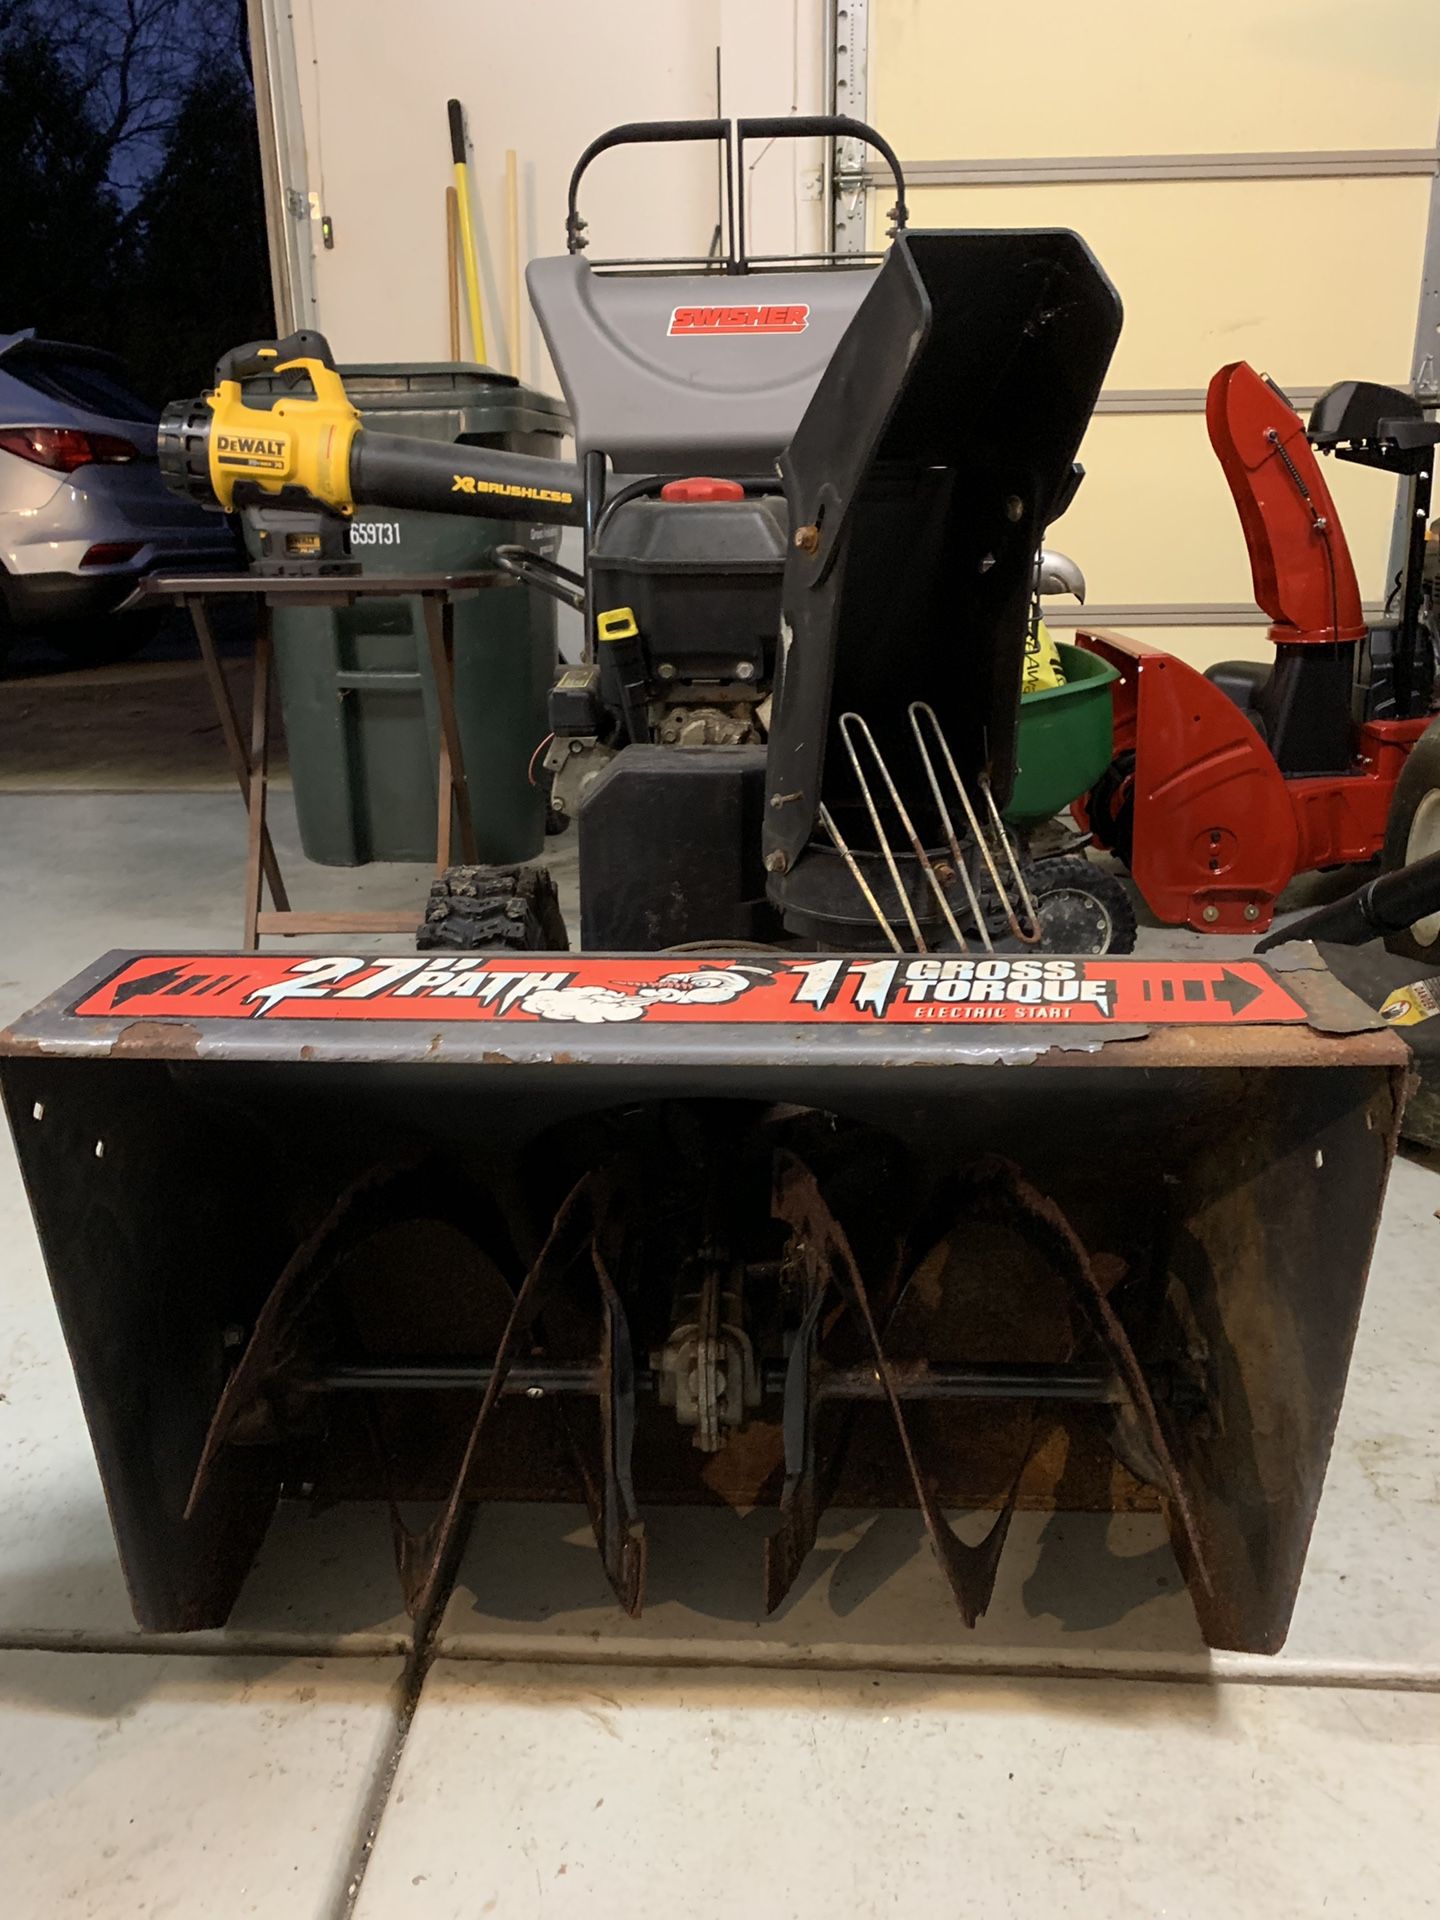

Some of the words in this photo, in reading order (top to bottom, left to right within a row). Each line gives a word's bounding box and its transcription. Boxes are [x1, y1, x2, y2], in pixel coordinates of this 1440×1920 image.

[673, 304, 809, 327] SWISHER
[452, 475, 477, 494] XR
[477, 481, 573, 504] BRUSHLESS
[350, 522, 401, 545] 659731
[393, 971, 571, 1016] PATH
[791, 959, 900, 1018] 11
[905, 960, 1076, 981] GROSS
[905, 979, 1108, 1017] TORQUE
[914, 1007, 1008, 1019] ELECTRIC
[1014, 1007, 1073, 1019] START
